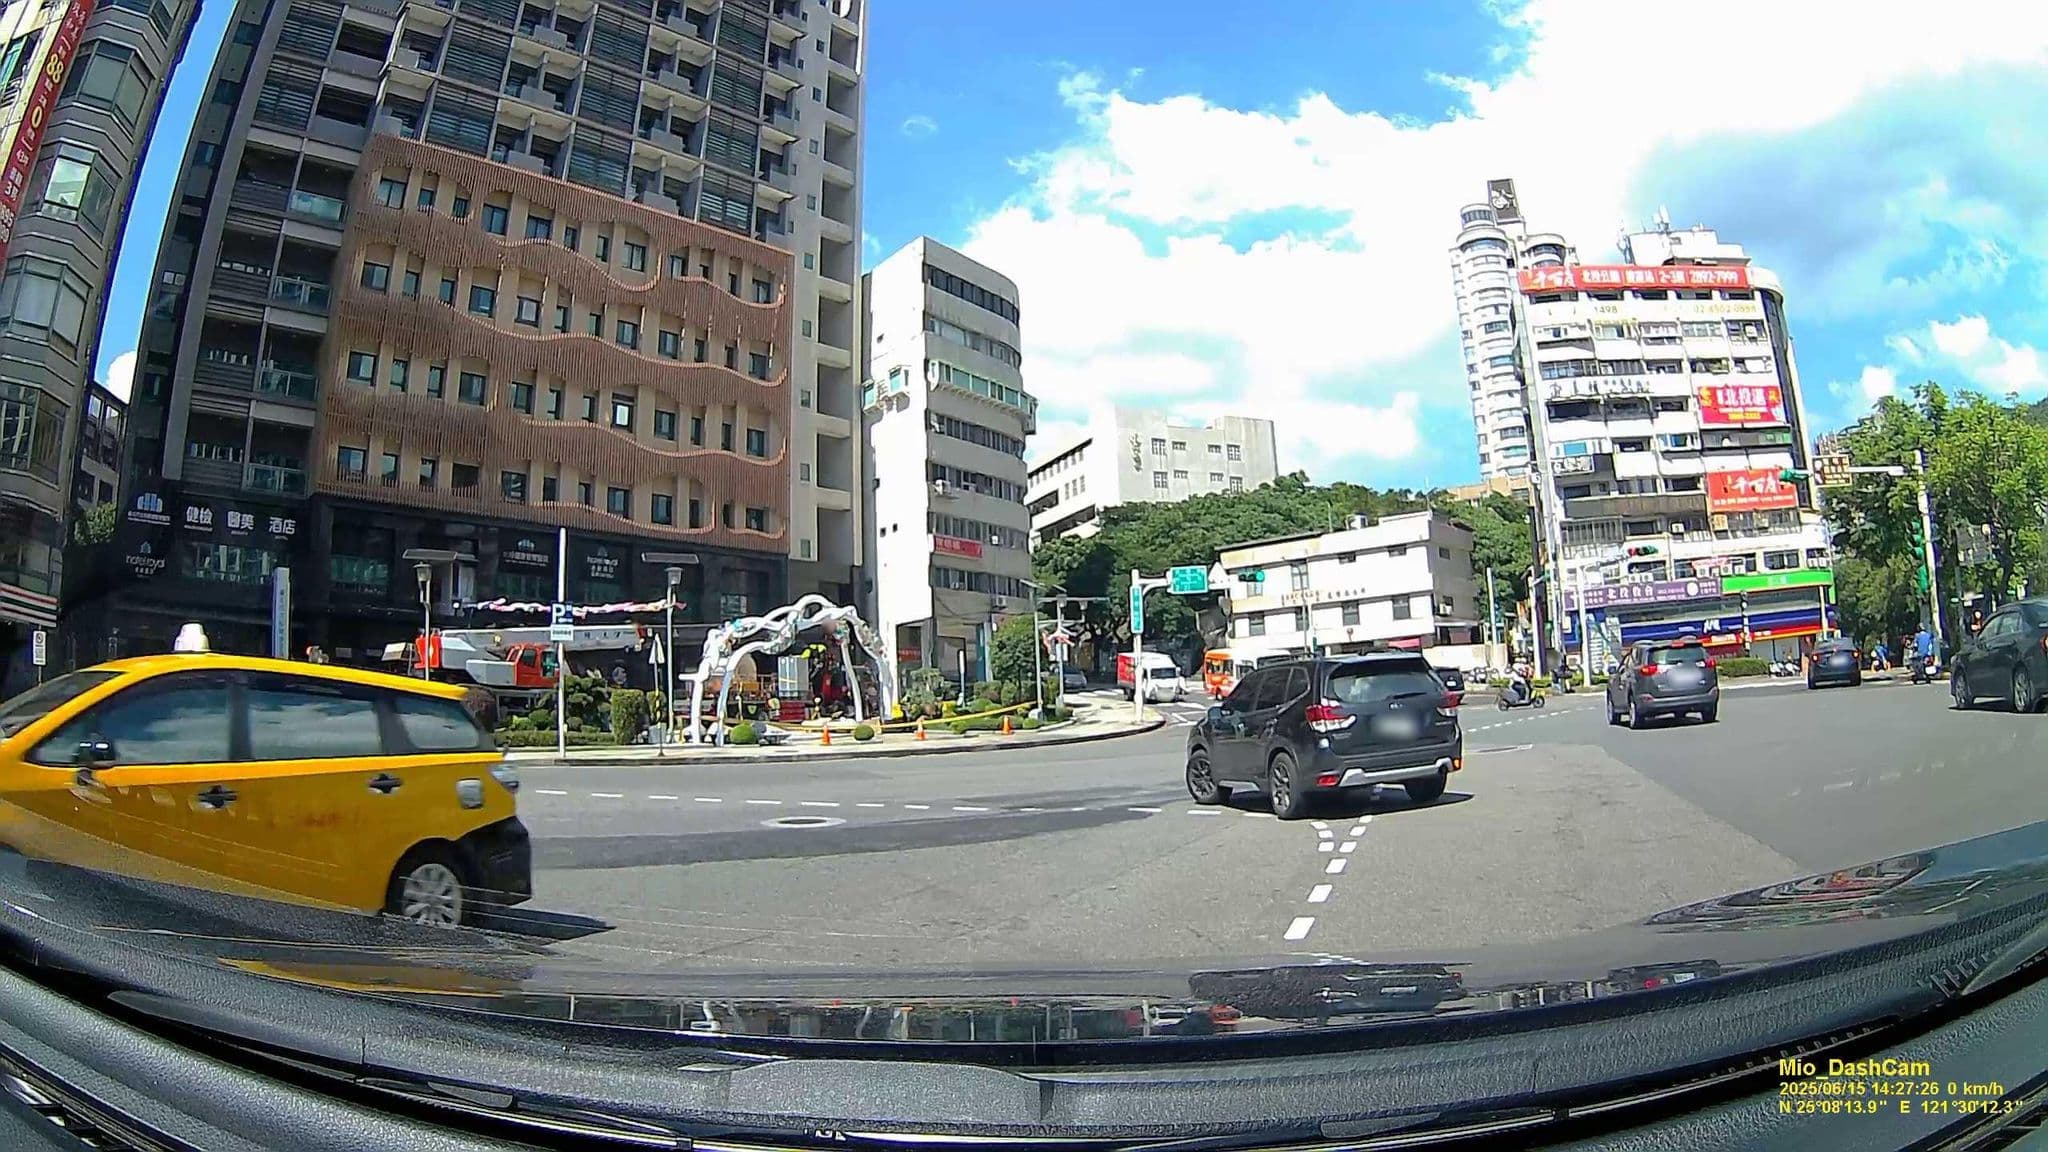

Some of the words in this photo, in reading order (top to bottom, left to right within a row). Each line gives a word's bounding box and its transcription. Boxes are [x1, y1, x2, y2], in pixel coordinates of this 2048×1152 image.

[185, 505, 215, 525] 健檢
[227, 510, 255, 531] 醫美
[268, 516, 297, 535] 酒店
[552, 603, 566, 624] P
